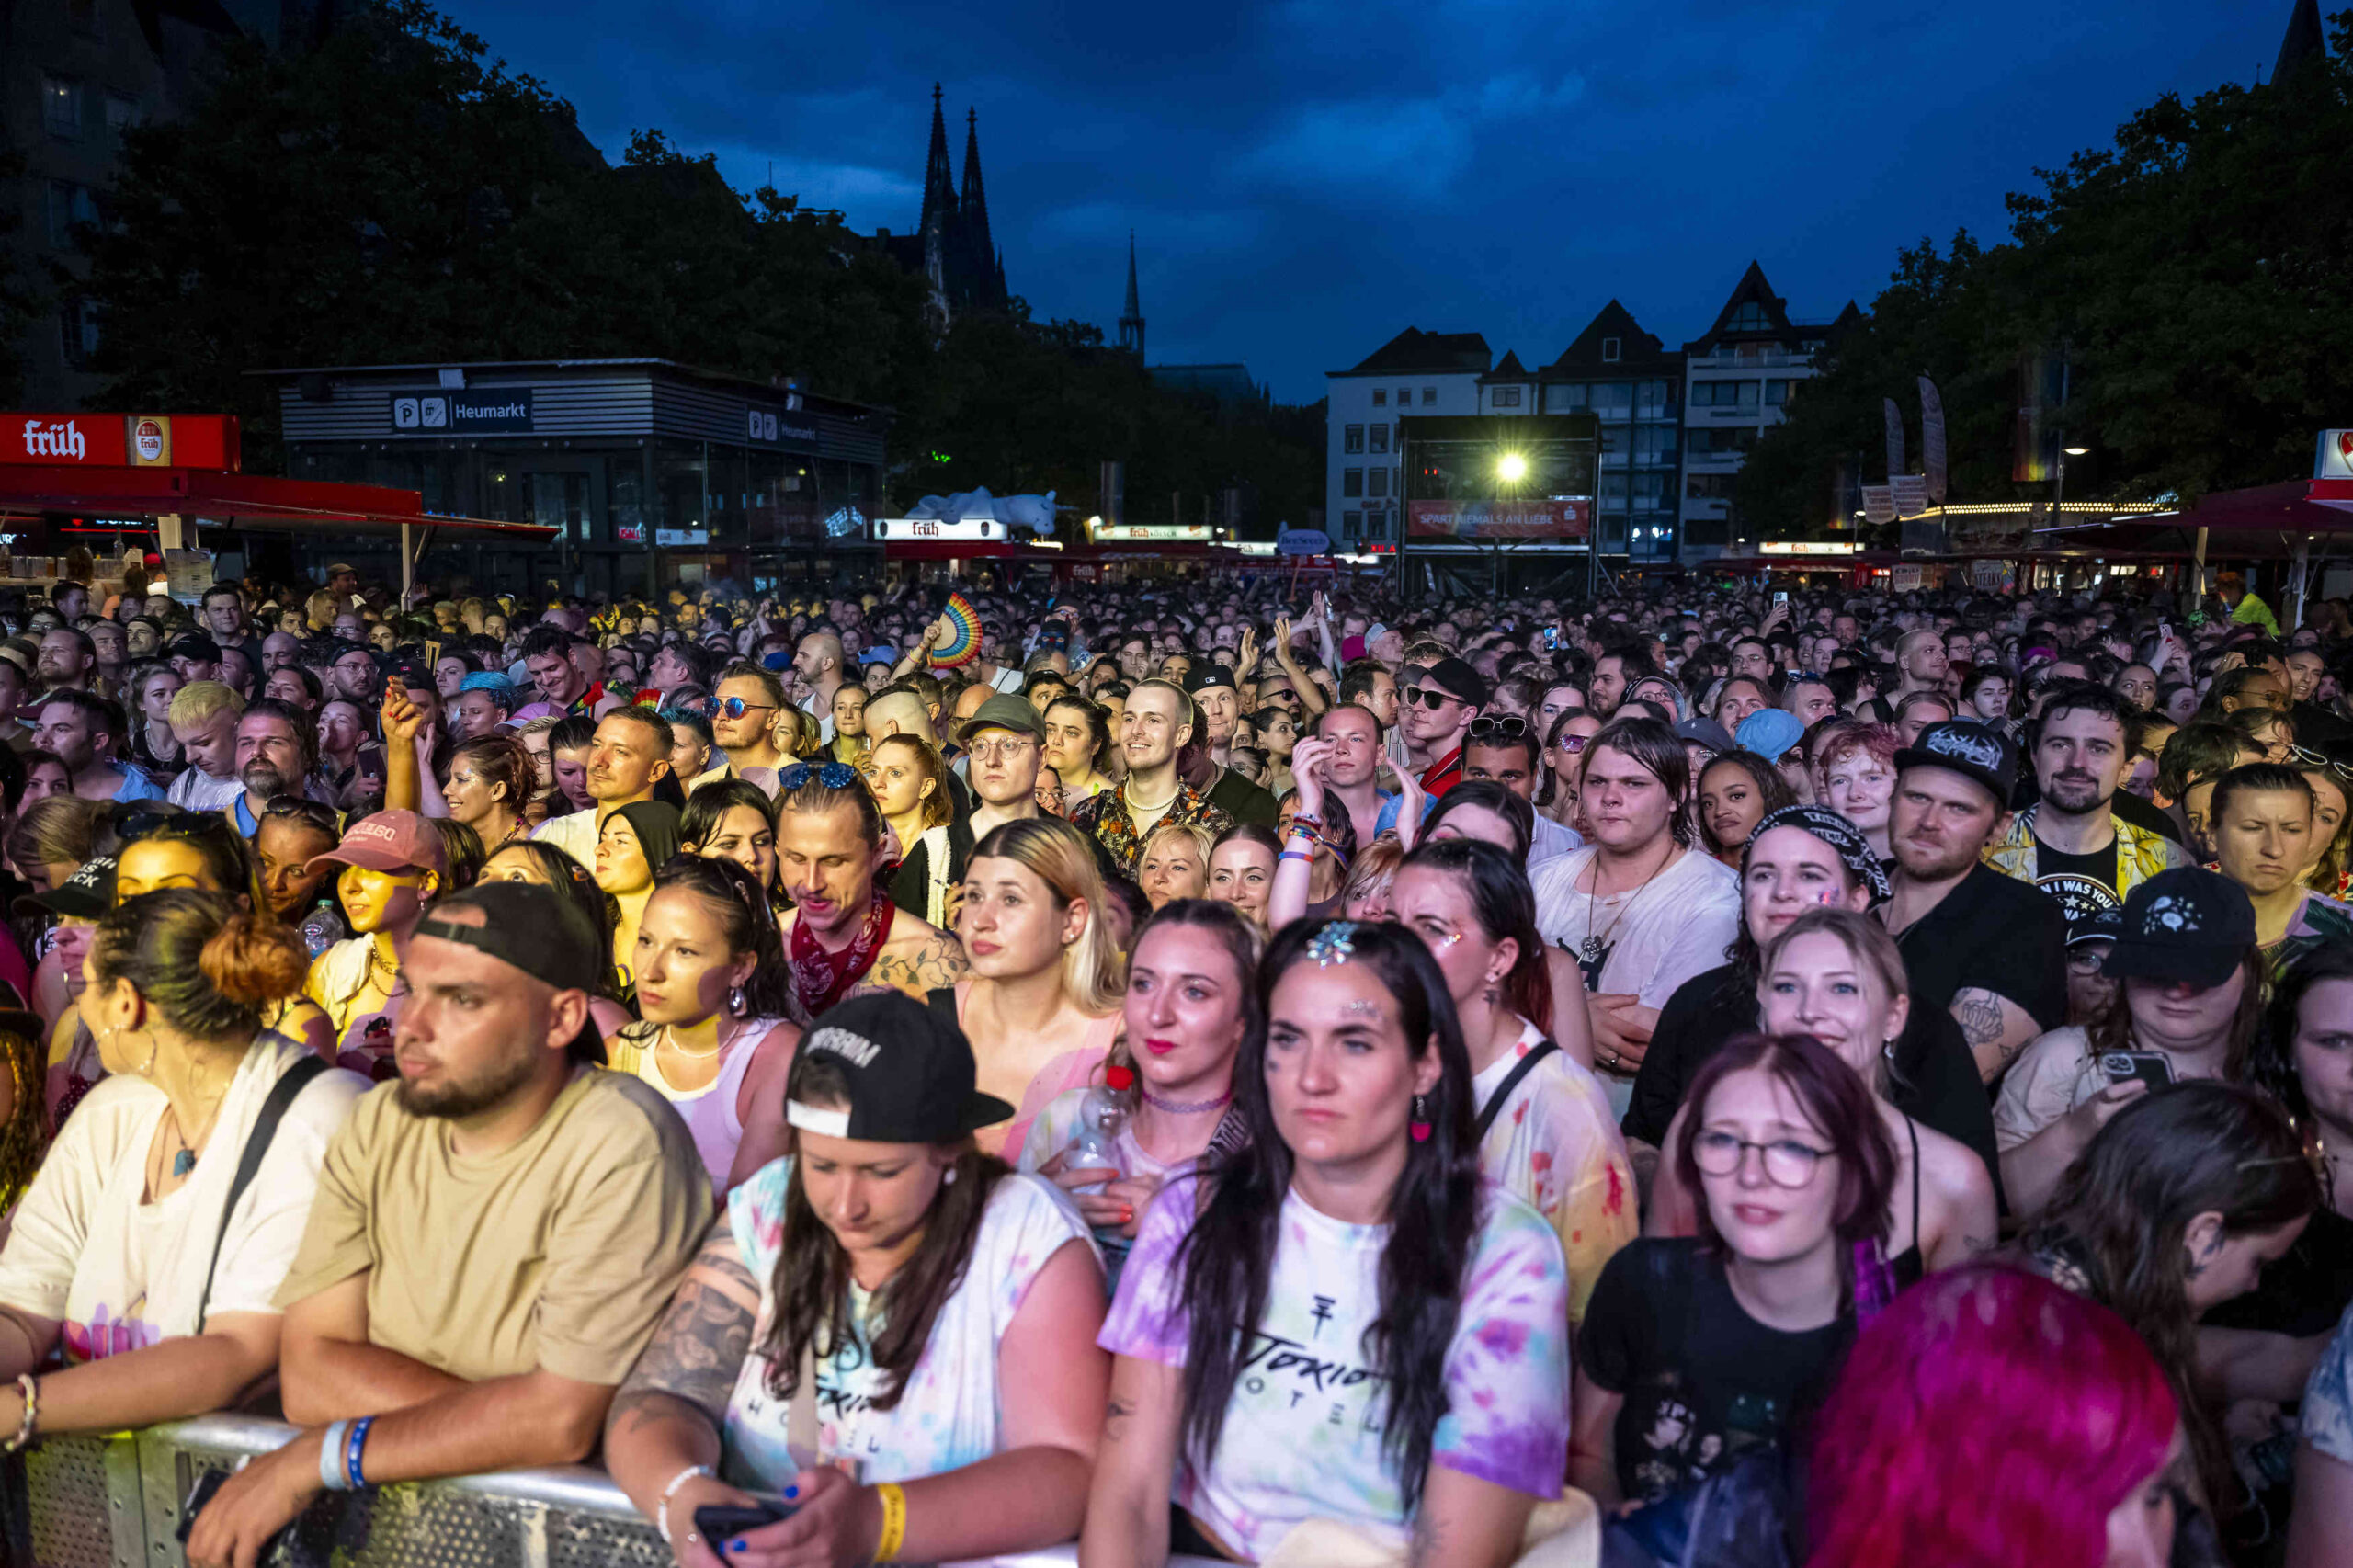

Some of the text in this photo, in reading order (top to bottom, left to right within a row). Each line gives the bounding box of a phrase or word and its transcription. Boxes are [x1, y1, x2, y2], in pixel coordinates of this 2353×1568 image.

[456, 403, 527, 419] Heumarkt
[1420, 514, 1553, 525] SPART NIEMALS AN LIEBE
[2063, 881, 2091, 895] WAS
[2092, 888, 2114, 909] YOU
[1245, 1375, 1381, 1434] OTEL
